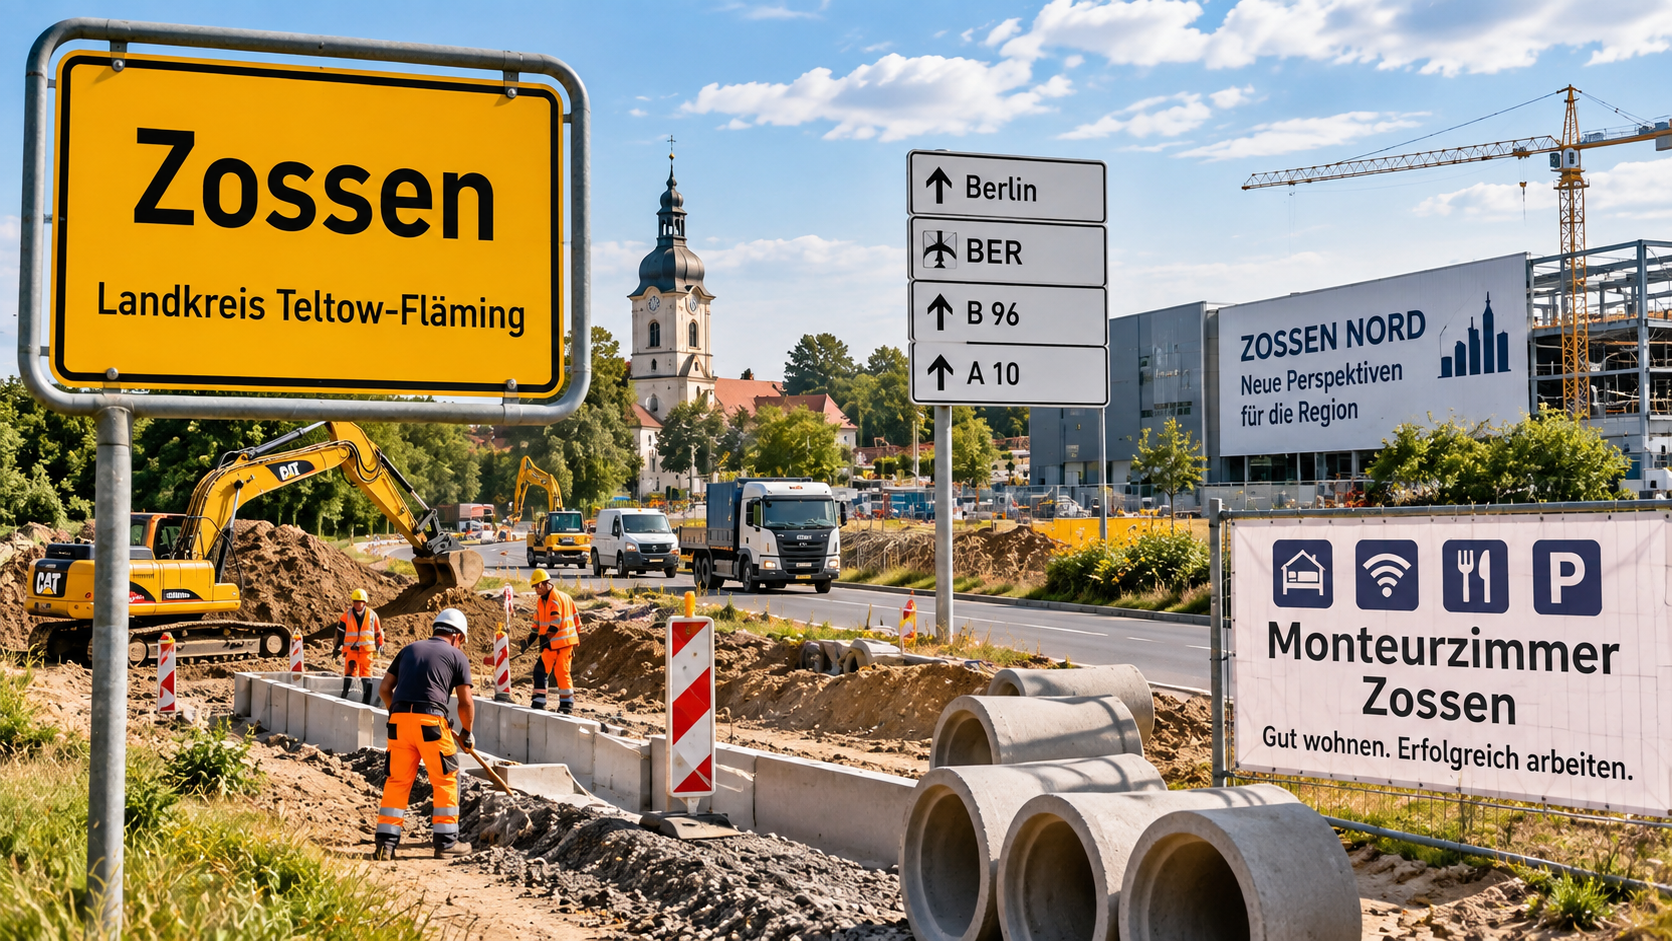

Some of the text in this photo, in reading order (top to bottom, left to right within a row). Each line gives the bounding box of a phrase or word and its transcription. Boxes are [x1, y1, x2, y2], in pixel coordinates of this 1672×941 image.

[133, 127, 494, 241] Zossen
[966, 174, 1037, 202] Berlin
[967, 238, 1023, 265] BER
[98, 281, 525, 338] Landkreis Teltow-Fläming
[967, 300, 1020, 326] B 96
[1240, 309, 1426, 362] ZOSSEN NORD
[966, 361, 1020, 386] A 10
[1241, 361, 1402, 396] Neue Perspektiven
[1241, 398, 1358, 428] für die Region
[36, 572, 61, 594] CAT
[1549, 552, 1586, 604] P
[1268, 621, 1620, 675] Monteurzimmer
[1362, 676, 1516, 725] Zossen
[1262, 726, 1634, 781] Gut wohnen. Erfolgreich arbeiten.
